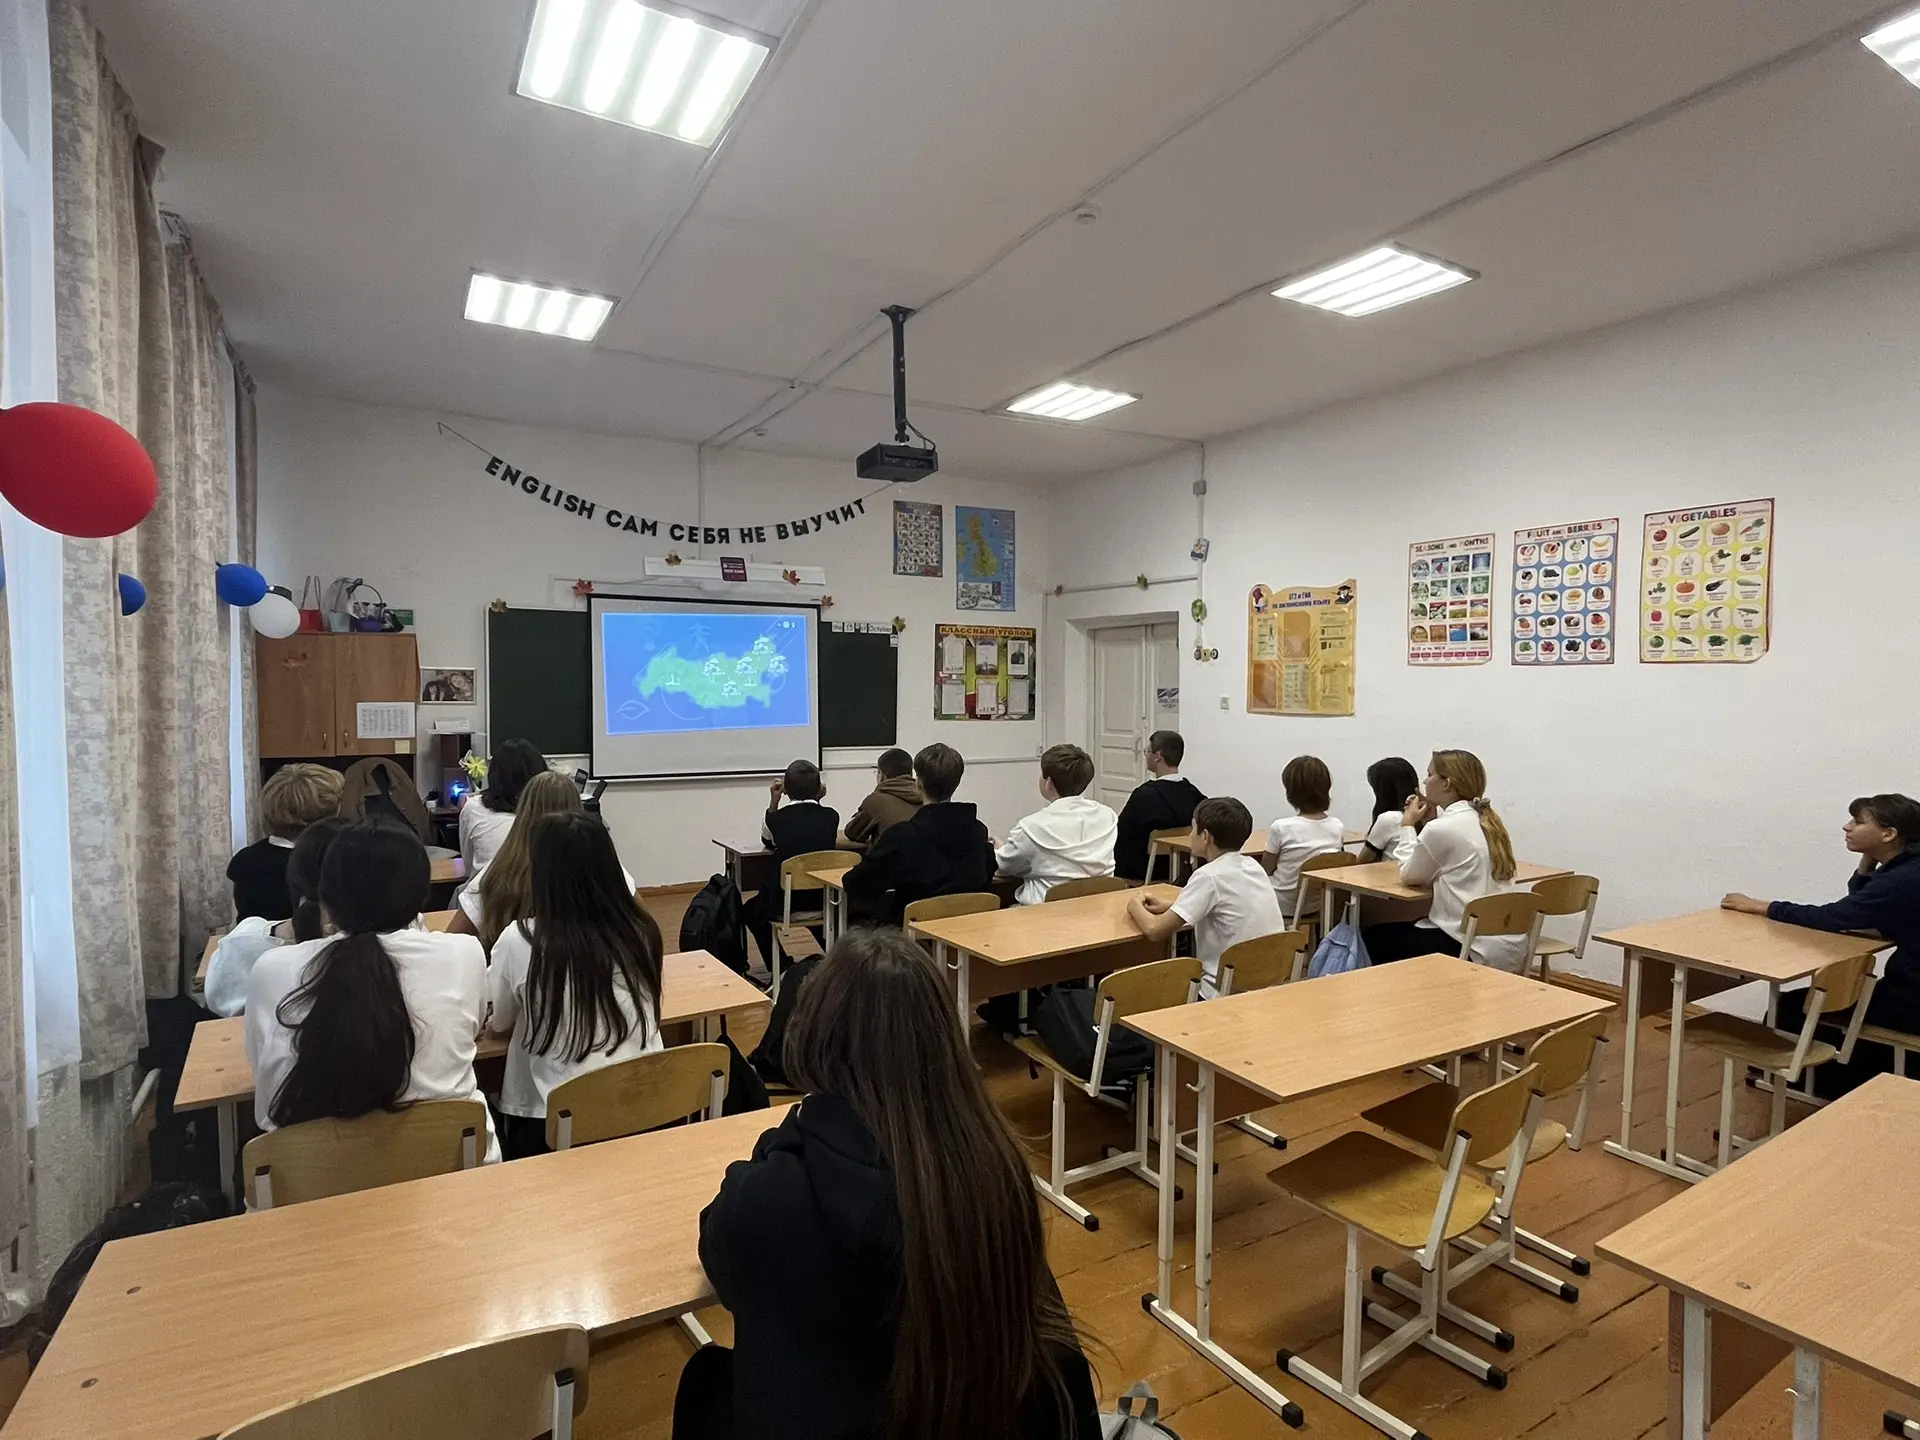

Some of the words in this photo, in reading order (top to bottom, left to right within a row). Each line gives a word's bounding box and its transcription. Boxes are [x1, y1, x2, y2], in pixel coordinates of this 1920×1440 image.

[485, 456, 596, 519] ENGLISH
[606, 509, 658, 536] САМ
[670, 524, 730, 544] СЕБЯ
[740, 526, 766, 544] НЕ
[776, 498, 865, 540] ВЫУЧИТ
[1527, 529, 1550, 539] FUIT
[1567, 522, 1602, 534] BERRES
[1460, 537, 1489, 548] ONTHS
